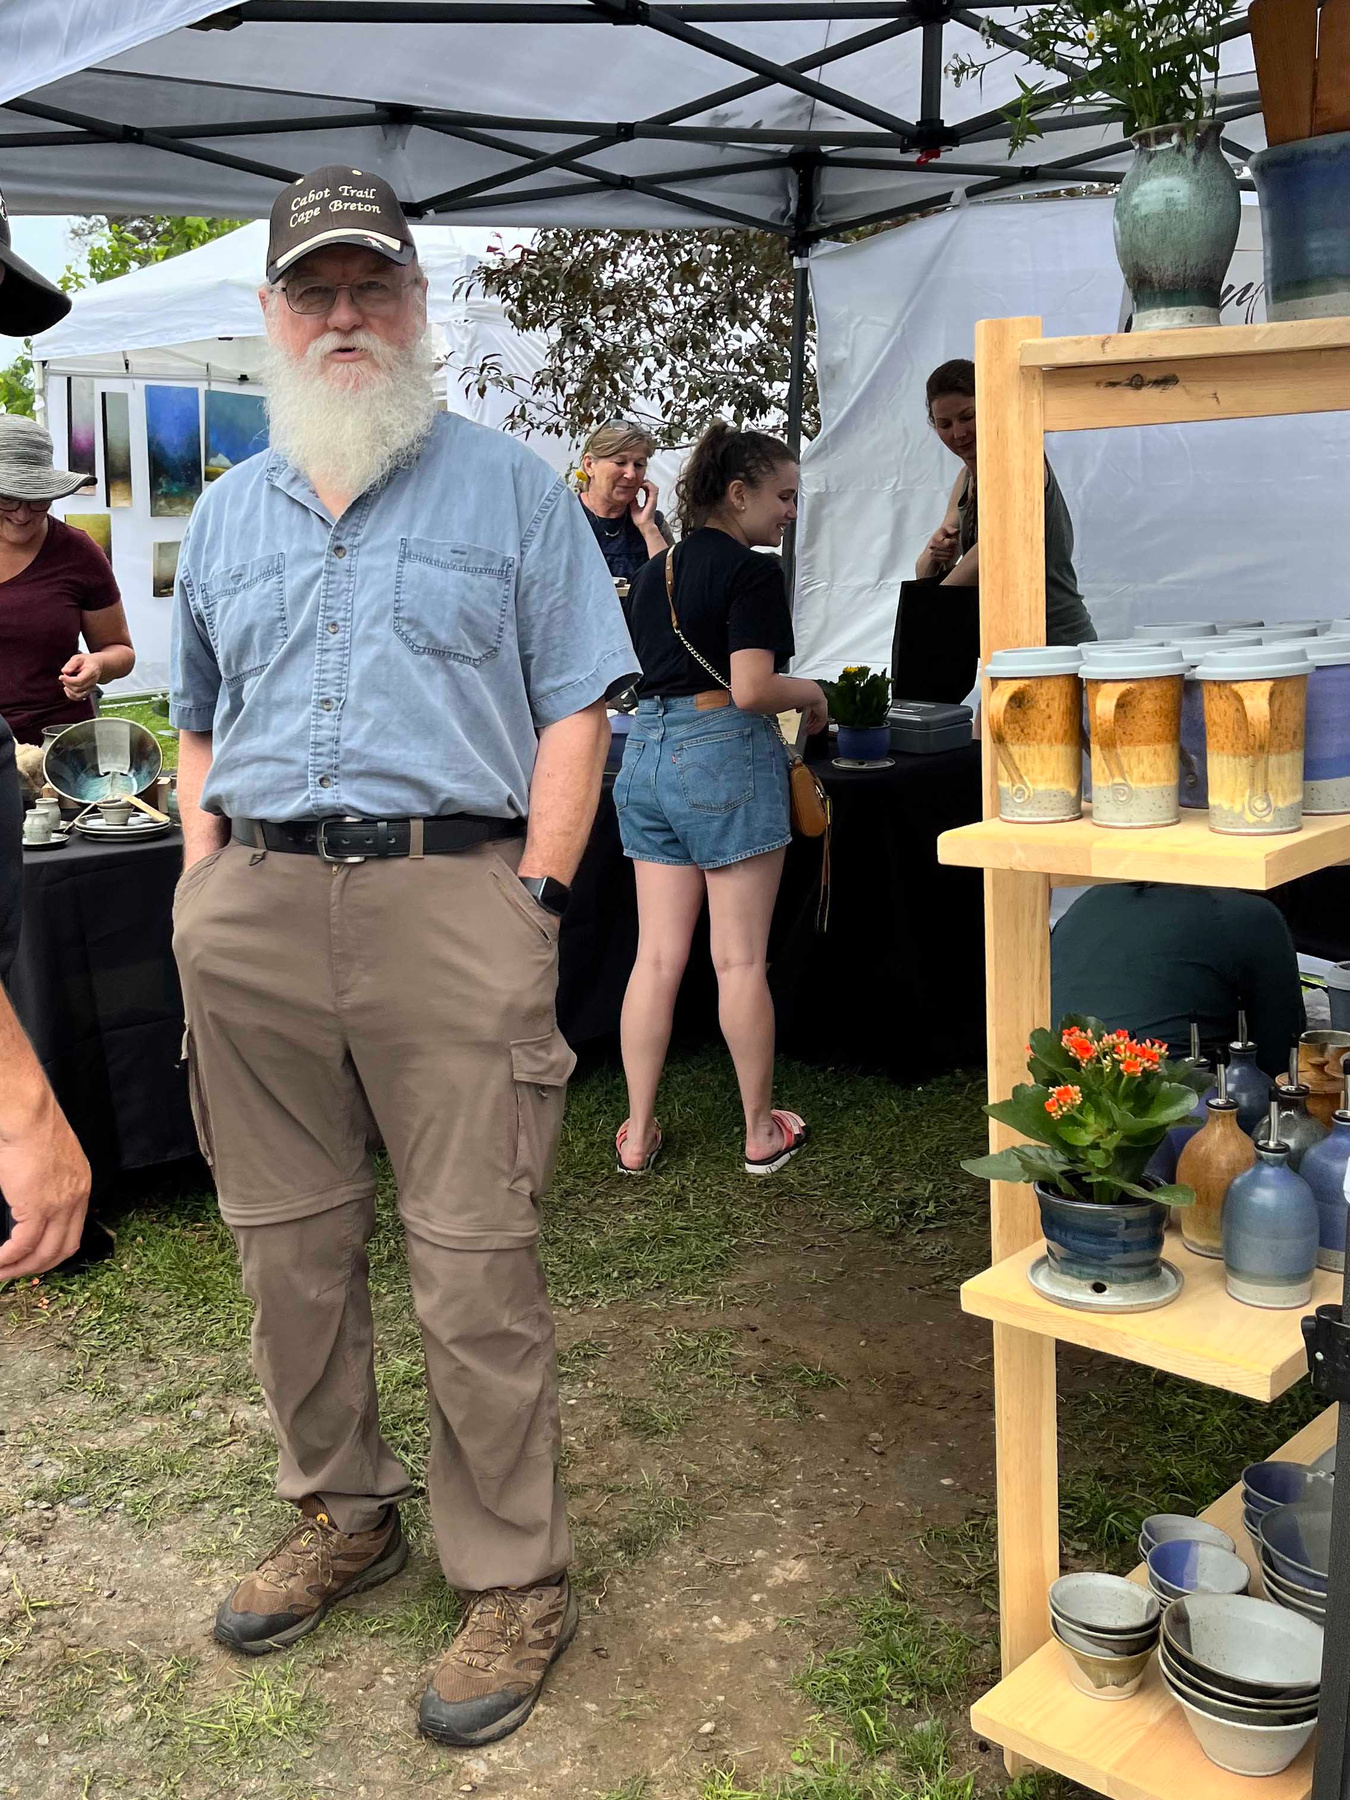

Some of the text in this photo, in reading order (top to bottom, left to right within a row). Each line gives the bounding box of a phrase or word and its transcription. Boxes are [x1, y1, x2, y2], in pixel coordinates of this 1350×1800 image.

[291, 185, 377, 211] Cabot Trail
[289, 199, 382, 228] Cape Breton
